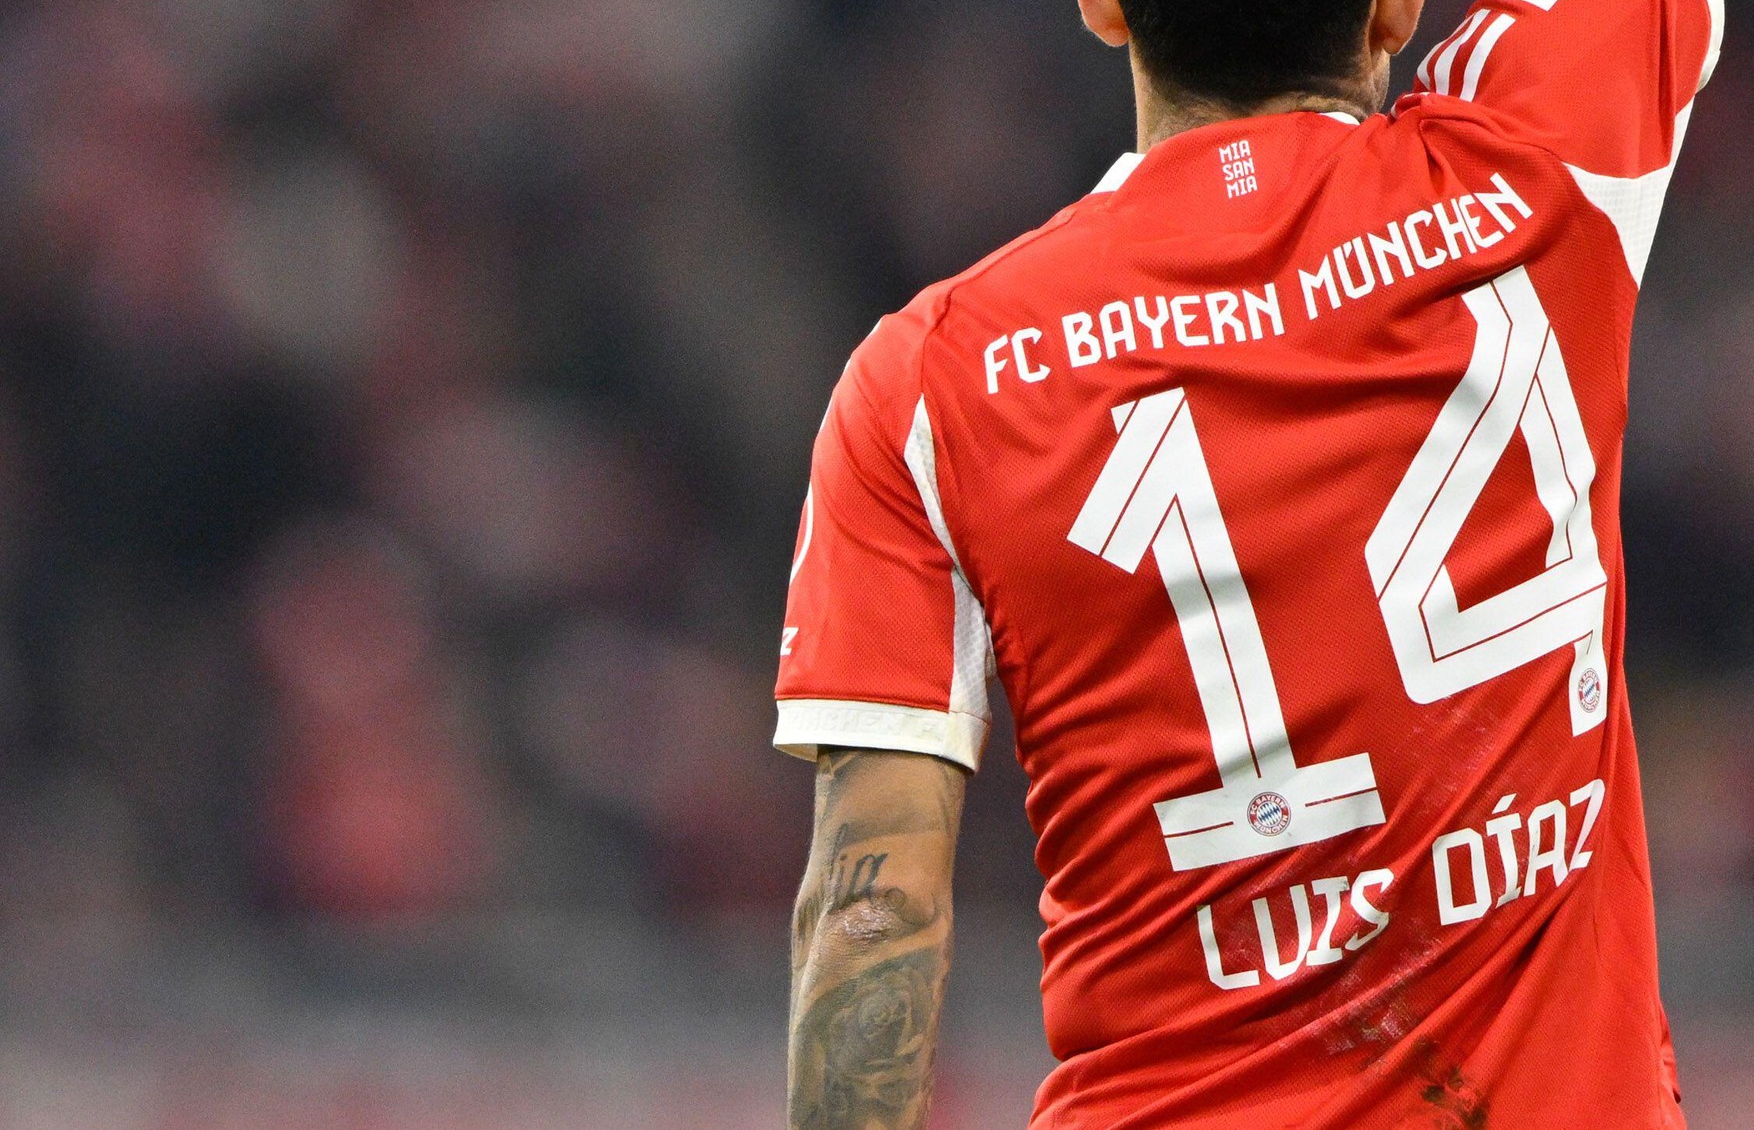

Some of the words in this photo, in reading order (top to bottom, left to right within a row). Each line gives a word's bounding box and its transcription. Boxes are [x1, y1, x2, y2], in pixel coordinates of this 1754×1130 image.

[1218, 139, 1251, 163] MIA
[1222, 157, 1255, 181] SAN
[1226, 174, 1258, 199] MIA
[983, 327, 1051, 395] FC
[1064, 282, 1285, 368] BAYERN
[1298, 172, 1534, 320] MÜNCHEN
[1066, 264, 1608, 872] 14
[1197, 868, 1395, 990] LUIS
[1432, 778, 1606, 926] DÍAZ
